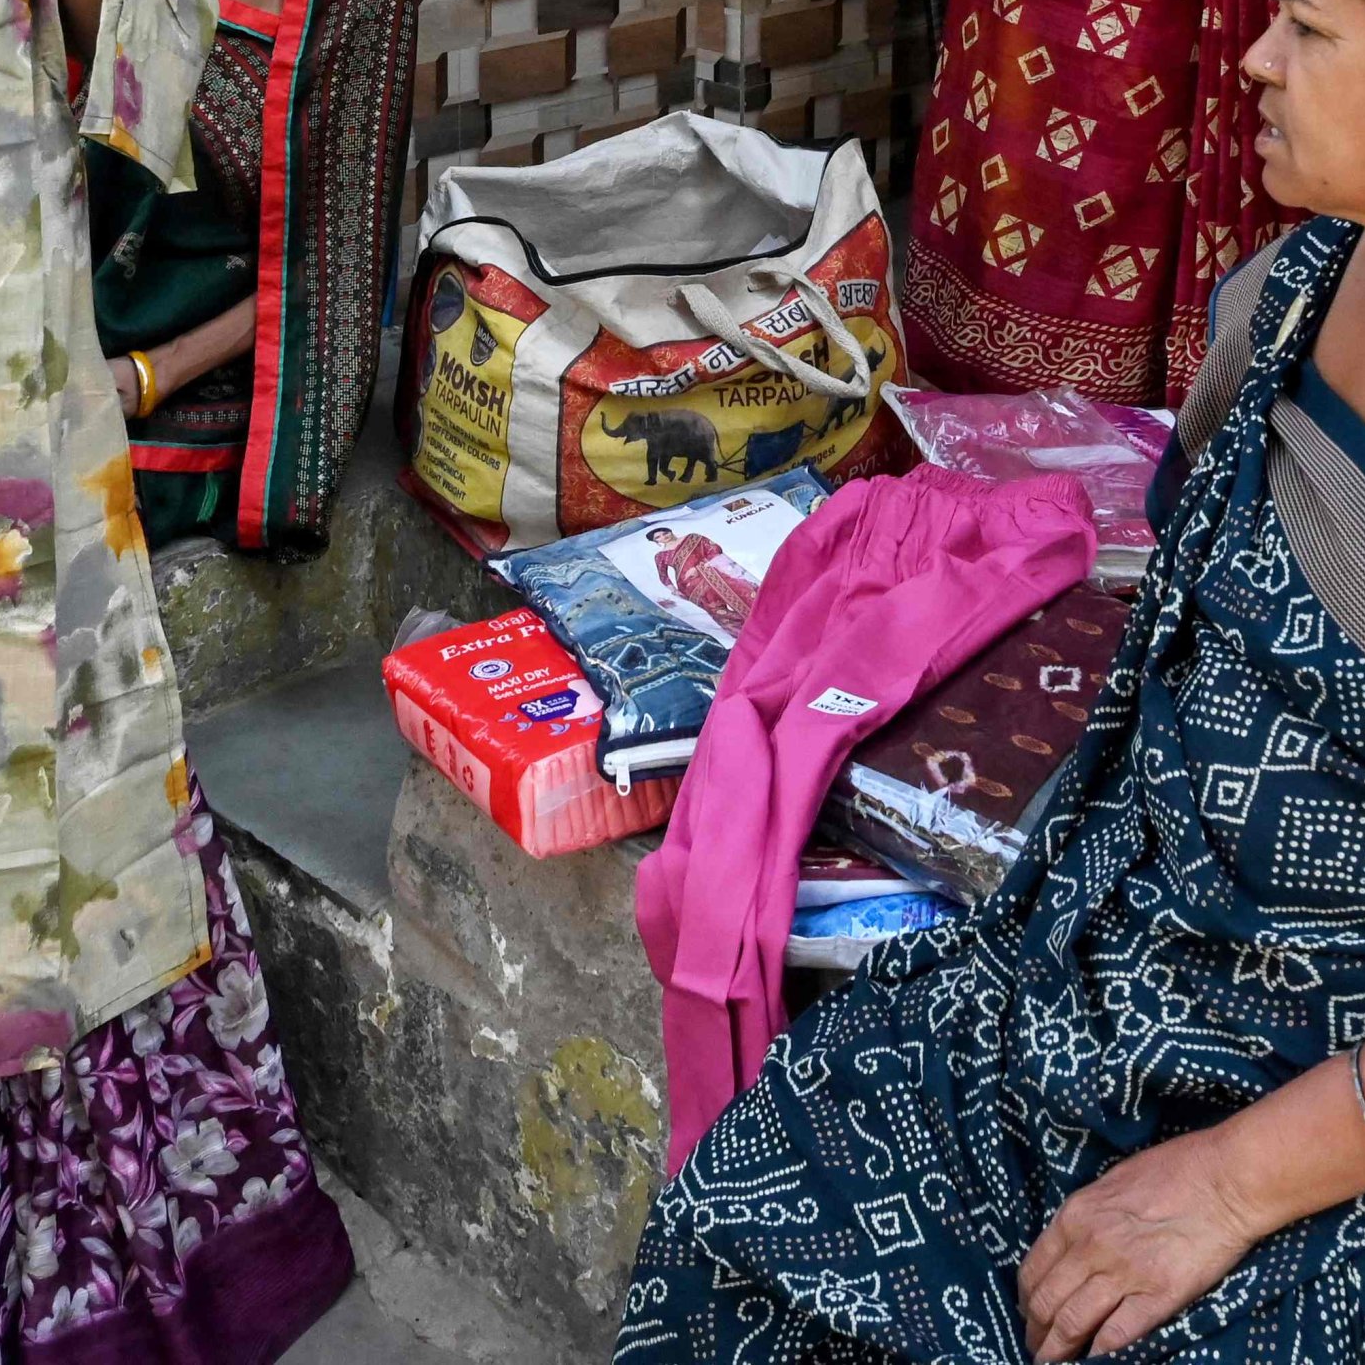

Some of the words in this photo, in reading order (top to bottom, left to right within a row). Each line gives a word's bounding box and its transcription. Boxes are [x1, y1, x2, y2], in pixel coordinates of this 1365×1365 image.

[438, 351, 506, 418] MOKSH
[435, 378, 502, 438] TARPAULIN
[430, 438, 458, 463] DURABLE
[467, 445, 501, 471] COLOURS
[439, 634, 513, 662] Extra
[518, 624, 547, 638] Pr
[487, 676, 522, 695] MAXI
[524, 667, 550, 682] DRY
[521, 699, 549, 714] 3X
[832, 693, 868, 707] XXL
